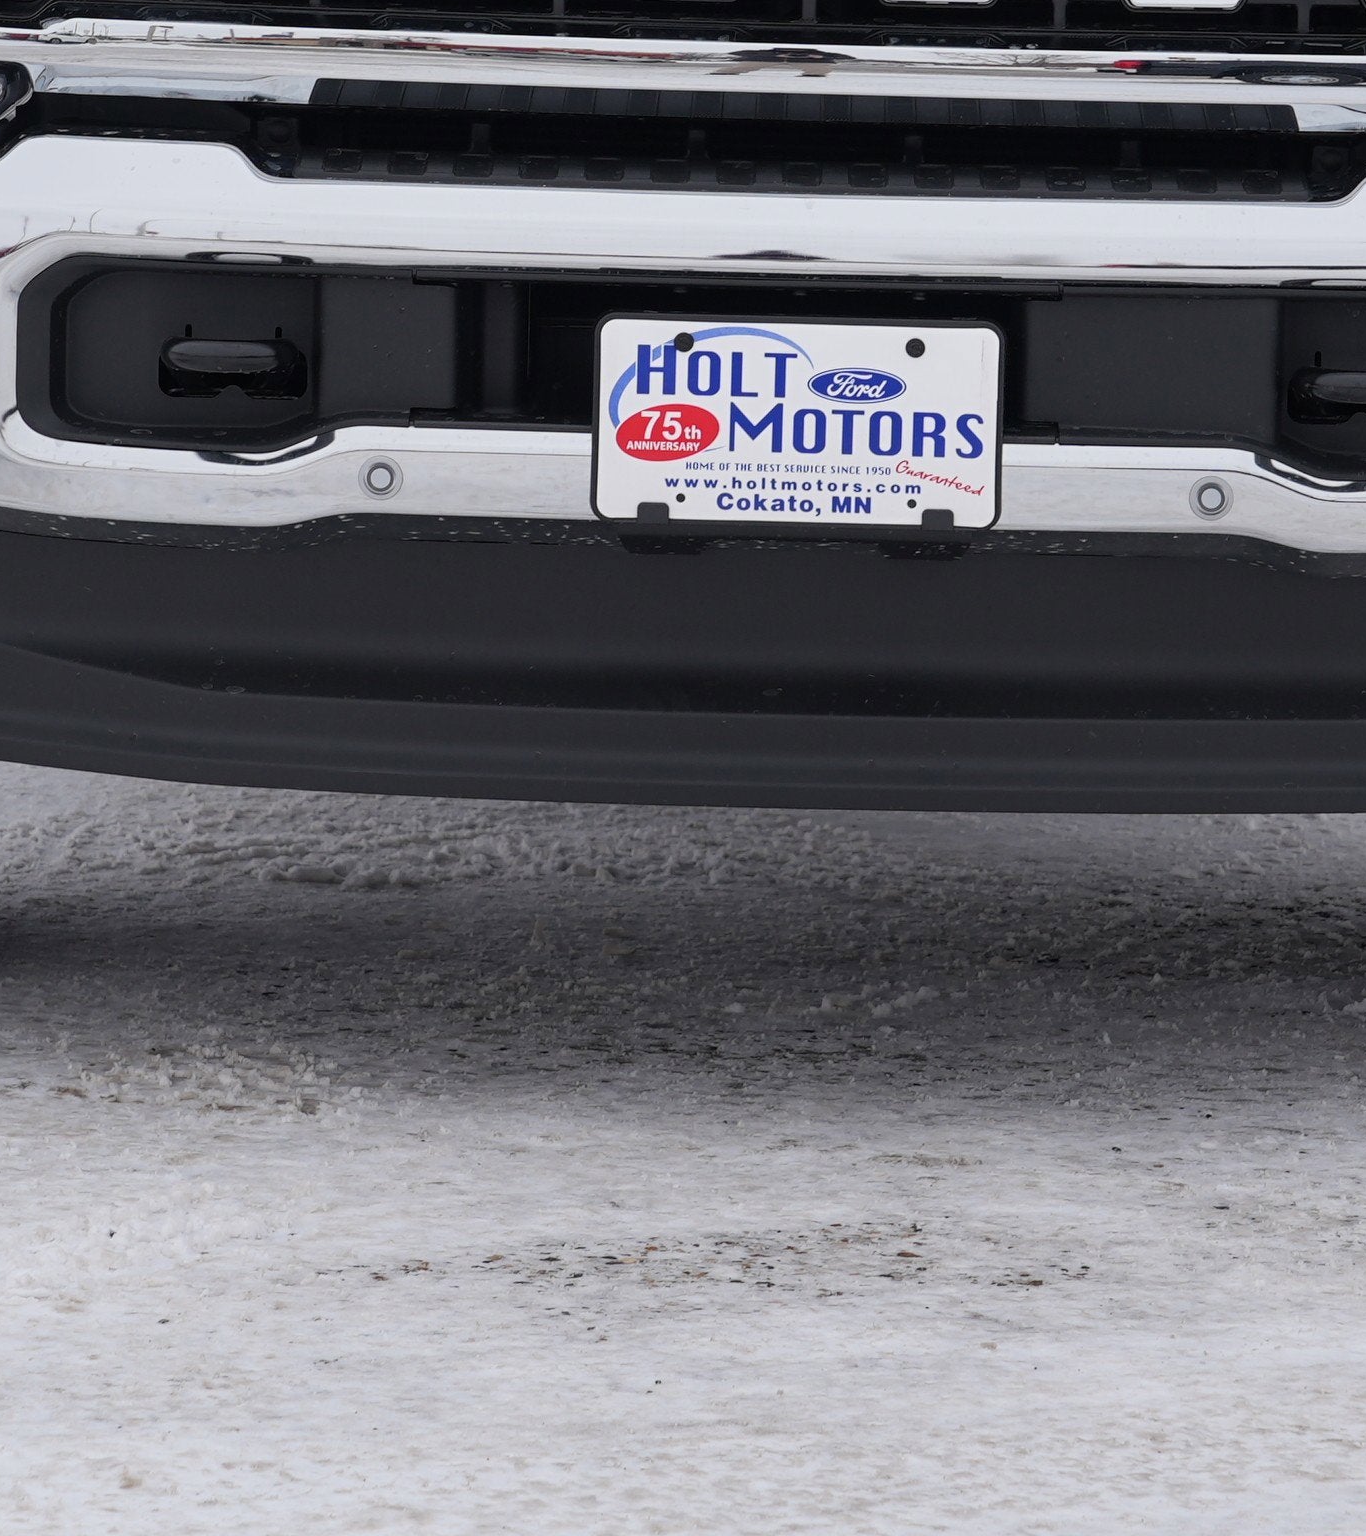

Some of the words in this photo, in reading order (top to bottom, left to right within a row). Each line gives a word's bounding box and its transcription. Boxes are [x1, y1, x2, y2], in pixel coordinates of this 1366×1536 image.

[636, 344, 798, 399] HOLT
[826, 369, 888, 399] Ford
[640, 410, 702, 441] 75th
[728, 401, 985, 460] MOTORS
[625, 439, 701, 452] ANNIVERSARY
[685, 461, 715, 471] HOME
[718, 462, 732, 472] OF
[735, 462, 753, 473] THE
[757, 463, 781, 474] BEST
[784, 464, 827, 475] SERVICE
[831, 465, 861, 476] SINCE
[865, 466, 891, 476] 1950
[895, 459, 986, 497] Guaranteed
[664, 476, 922, 495] www.holtmotors.com
[716, 492, 822, 517] Cokato,
[831, 495, 872, 514] MN
